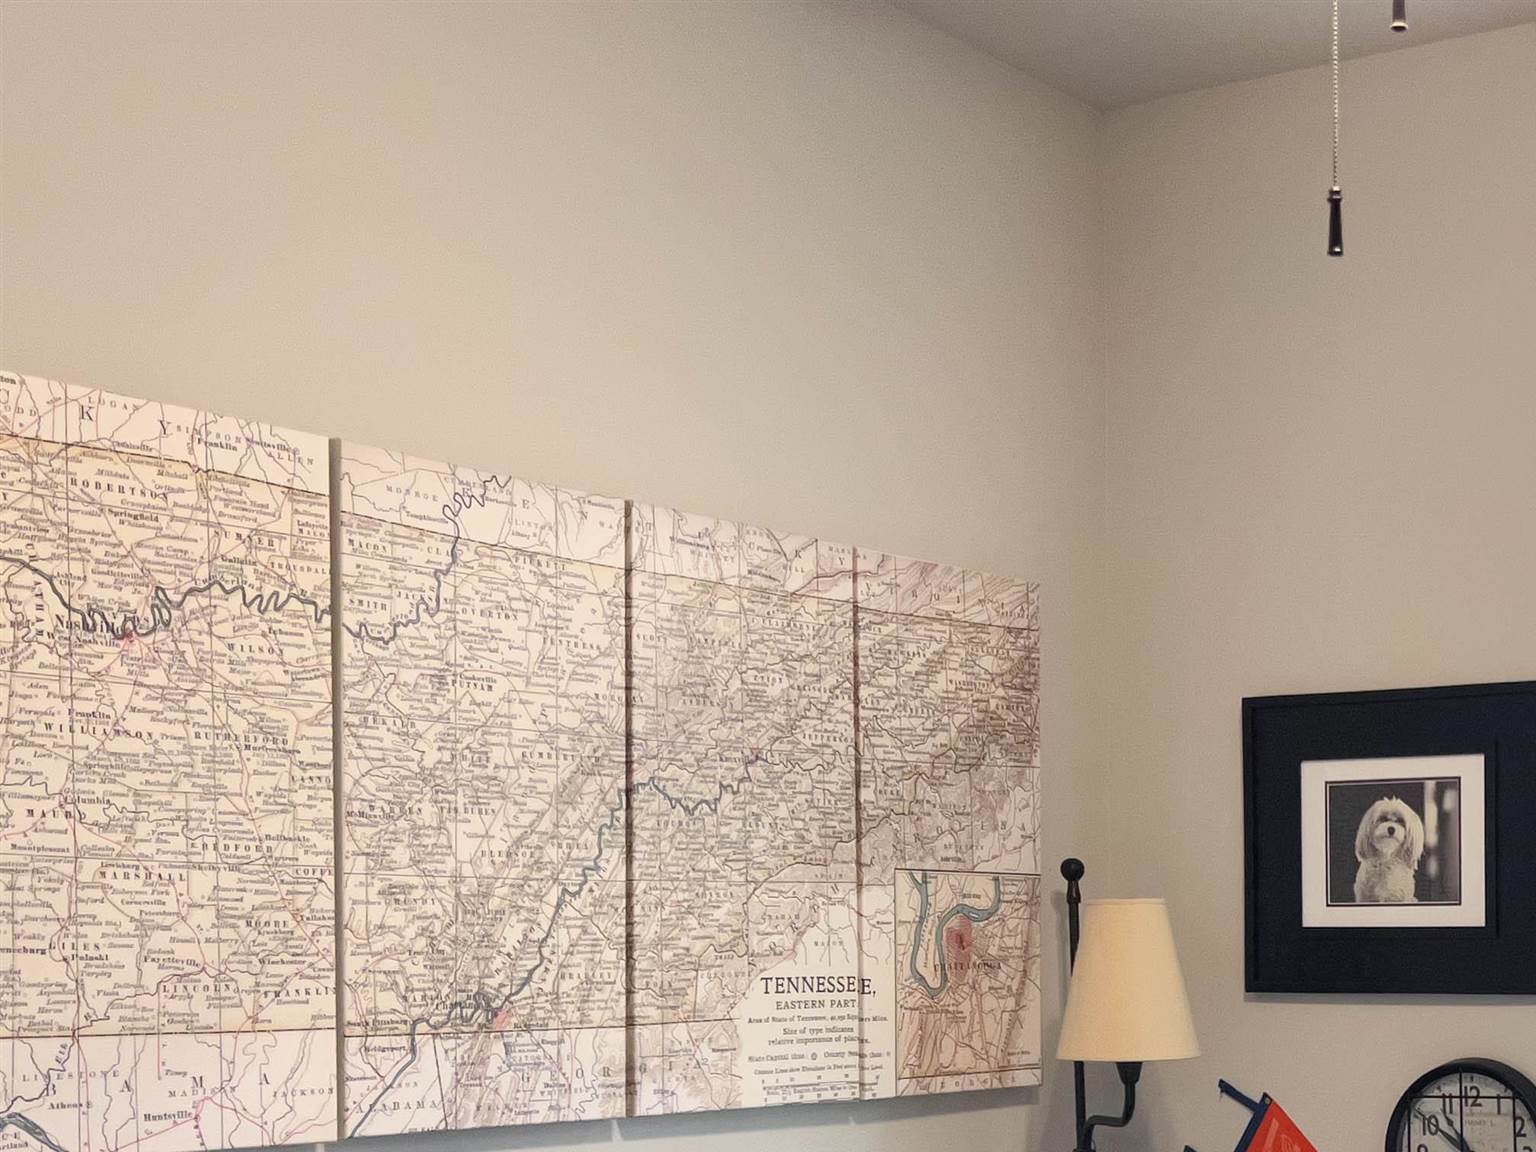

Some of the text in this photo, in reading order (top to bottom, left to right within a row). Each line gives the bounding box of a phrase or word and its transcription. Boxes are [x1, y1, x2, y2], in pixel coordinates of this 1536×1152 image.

[198, 437, 238, 452] Franklin
[70, 477, 169, 501] ROBERTSON
[98, 869, 187, 882] MARSHALL
[245, 919, 289, 929] MOORE
[161, 983, 231, 994] LINCOLN
[775, 999, 857, 1011] EASTERN PART
[782, 1025, 855, 1036] Size of type indicates
[767, 1037, 795, 1047] relative
[795, 1036, 834, 1046] importance
[834, 1034, 842, 1043] of
[272, 1087, 335, 1098] JACKSON
[1464, 1085, 1483, 1108] 12
[48, 1101, 83, 1111] Athens
[1442, 1092, 1454, 1115] 11
[143, 1110, 193, 1122] Huntsville
[1422, 1114, 1440, 1137] 10
[1515, 1116, 1527, 1138] 2
